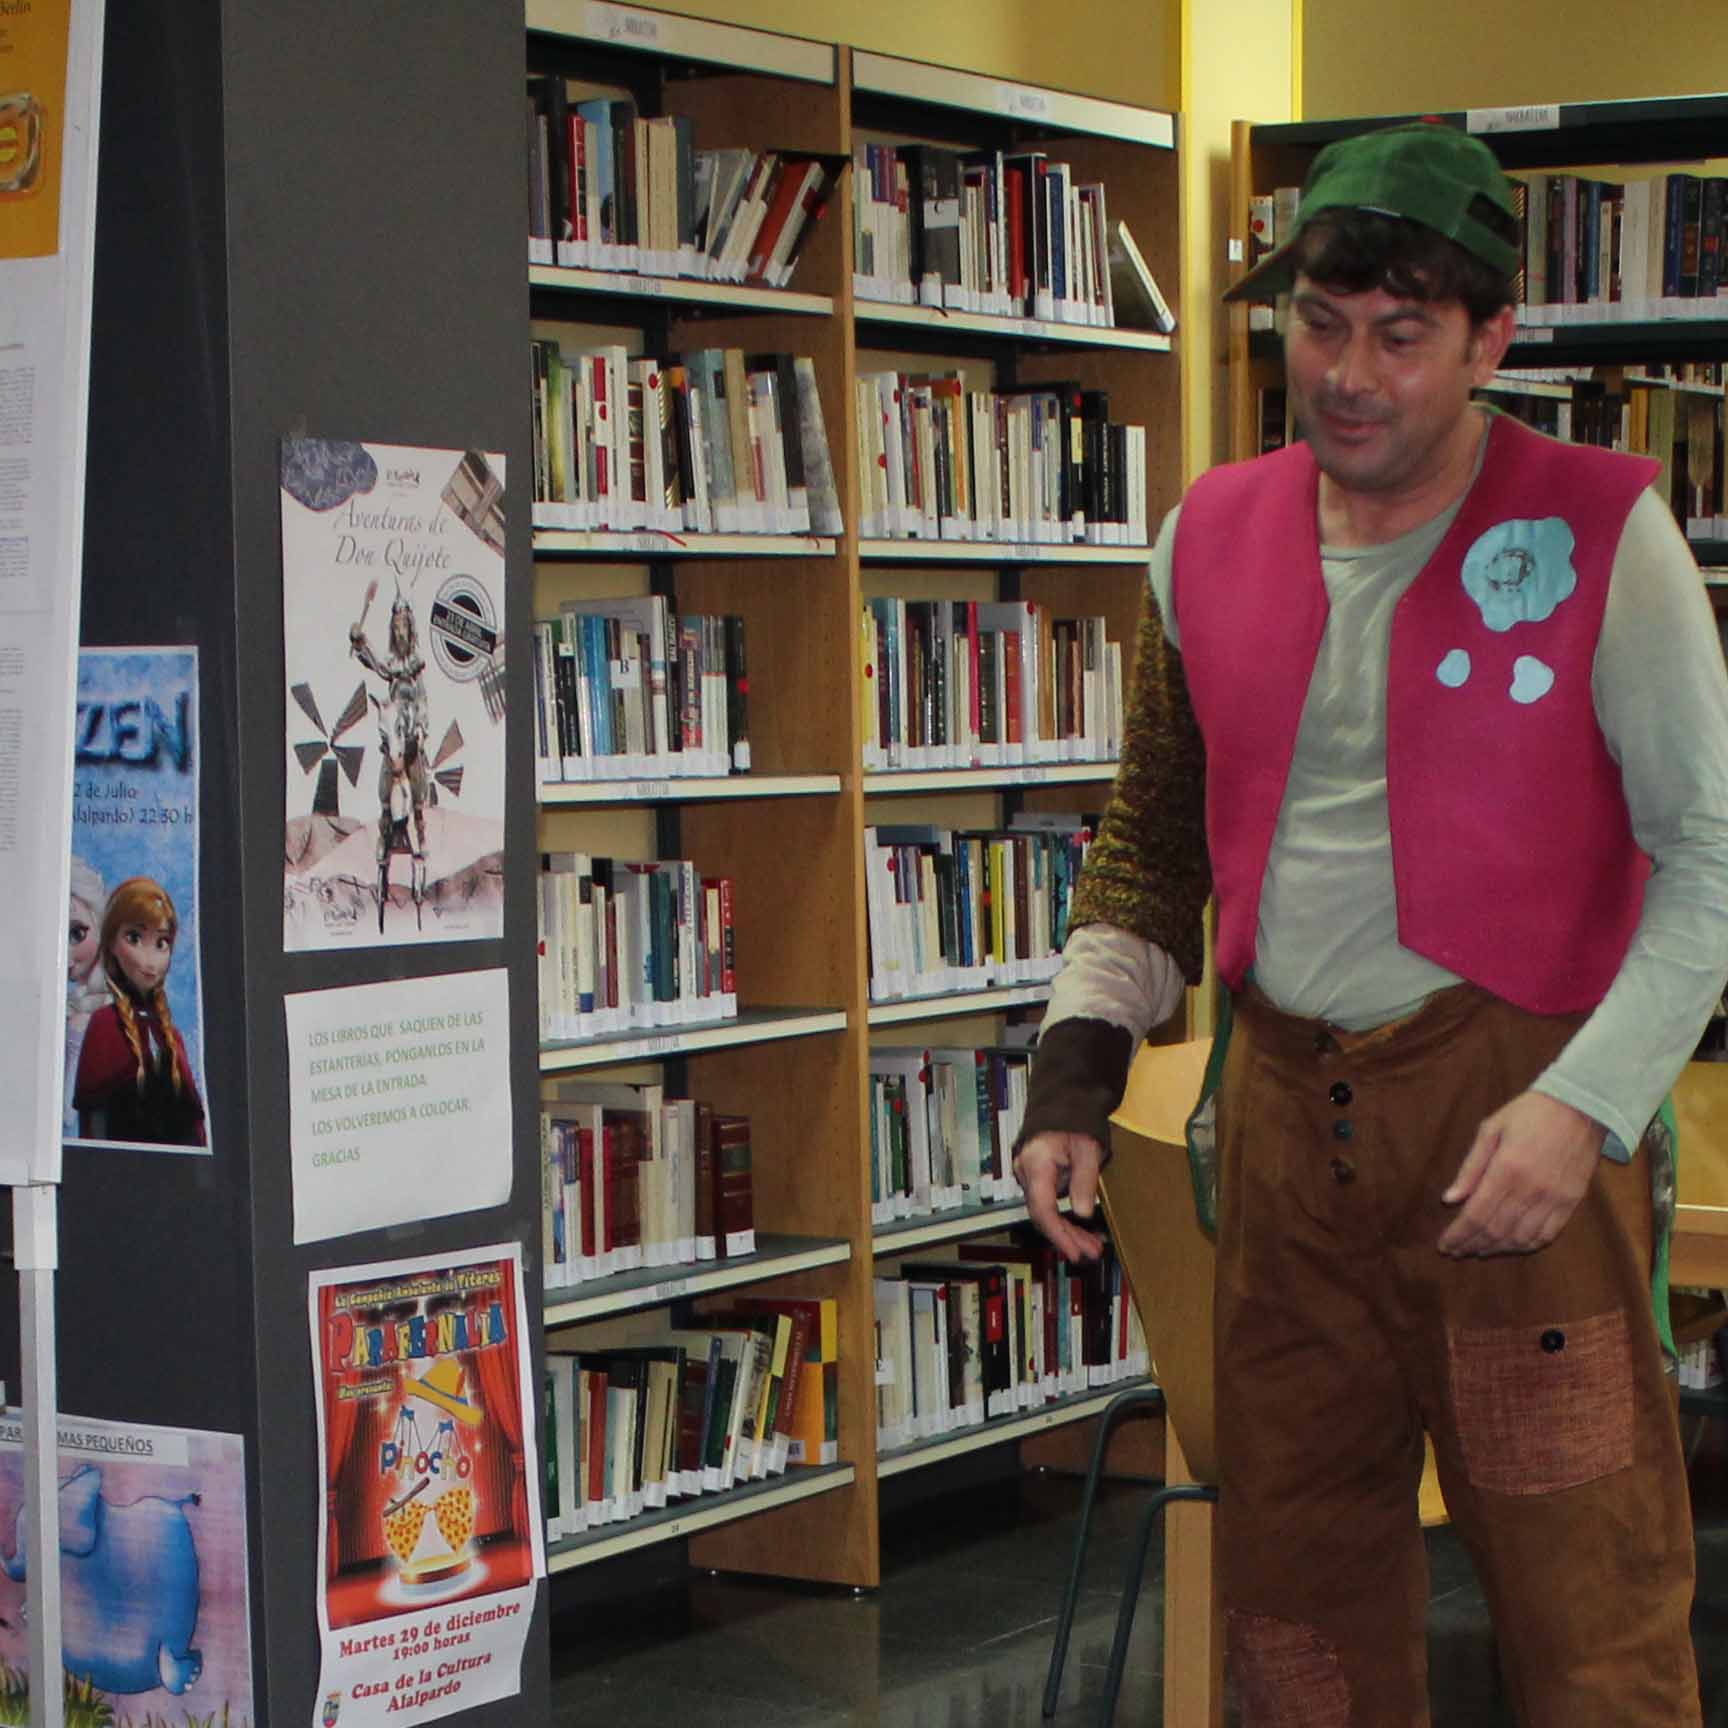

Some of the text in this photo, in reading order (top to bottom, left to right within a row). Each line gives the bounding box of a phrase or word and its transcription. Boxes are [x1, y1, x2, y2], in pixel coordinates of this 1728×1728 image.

[335, 535, 451, 584] Don Quijote
[308, 1011, 484, 1049] LOS LIBROS QUE SAQUEN DE LAS
[455, 1039, 470, 1054] EN
[471, 1038, 486, 1053] LA
[310, 1086, 344, 1105] MESA
[344, 1083, 359, 1099] DE
[361, 1080, 374, 1097] LA
[312, 1120, 333, 1137] LOS
[335, 1107, 408, 1132] VOLVEREMOS
[410, 1105, 417, 1119] A
[312, 1146, 361, 1168] GRACIAS
[328, 1302, 508, 1374] PARAFERNALIA
[86, 1433, 154, 1454] PEQUEÑOS
[339, 1602, 521, 1658] Martes 29 de diciembre
[392, 1631, 472, 1661] 19:00 horas
[351, 1652, 493, 1700] Casa de la Cultura
[385, 1678, 462, 1714] Alalpardo
